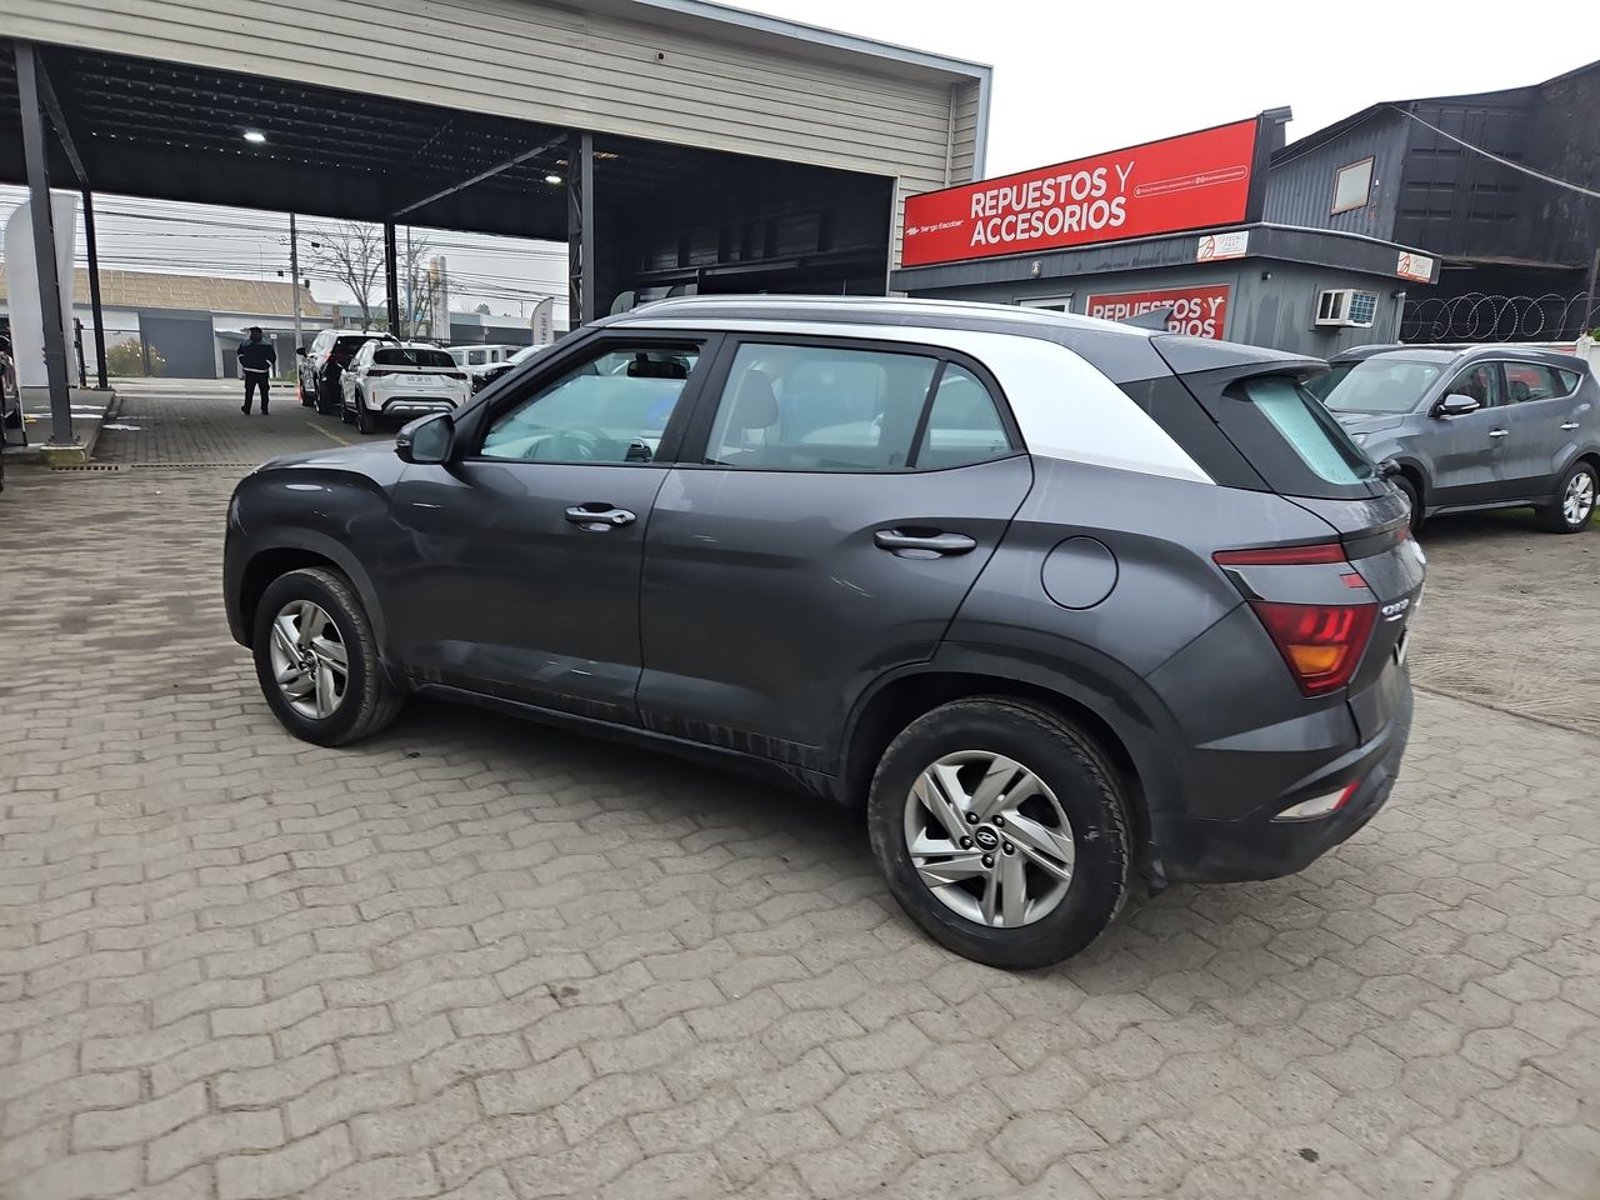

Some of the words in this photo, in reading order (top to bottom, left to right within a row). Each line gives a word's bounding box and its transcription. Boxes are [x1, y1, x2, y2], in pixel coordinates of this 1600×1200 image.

[971, 167, 1107, 219] REPUESTOS
[1115, 161, 1134, 192] Y
[970, 196, 1126, 247] ACCESORIOS
[1093, 298, 1201, 322] REPUEOS
[1208, 296, 1223, 317] Y
